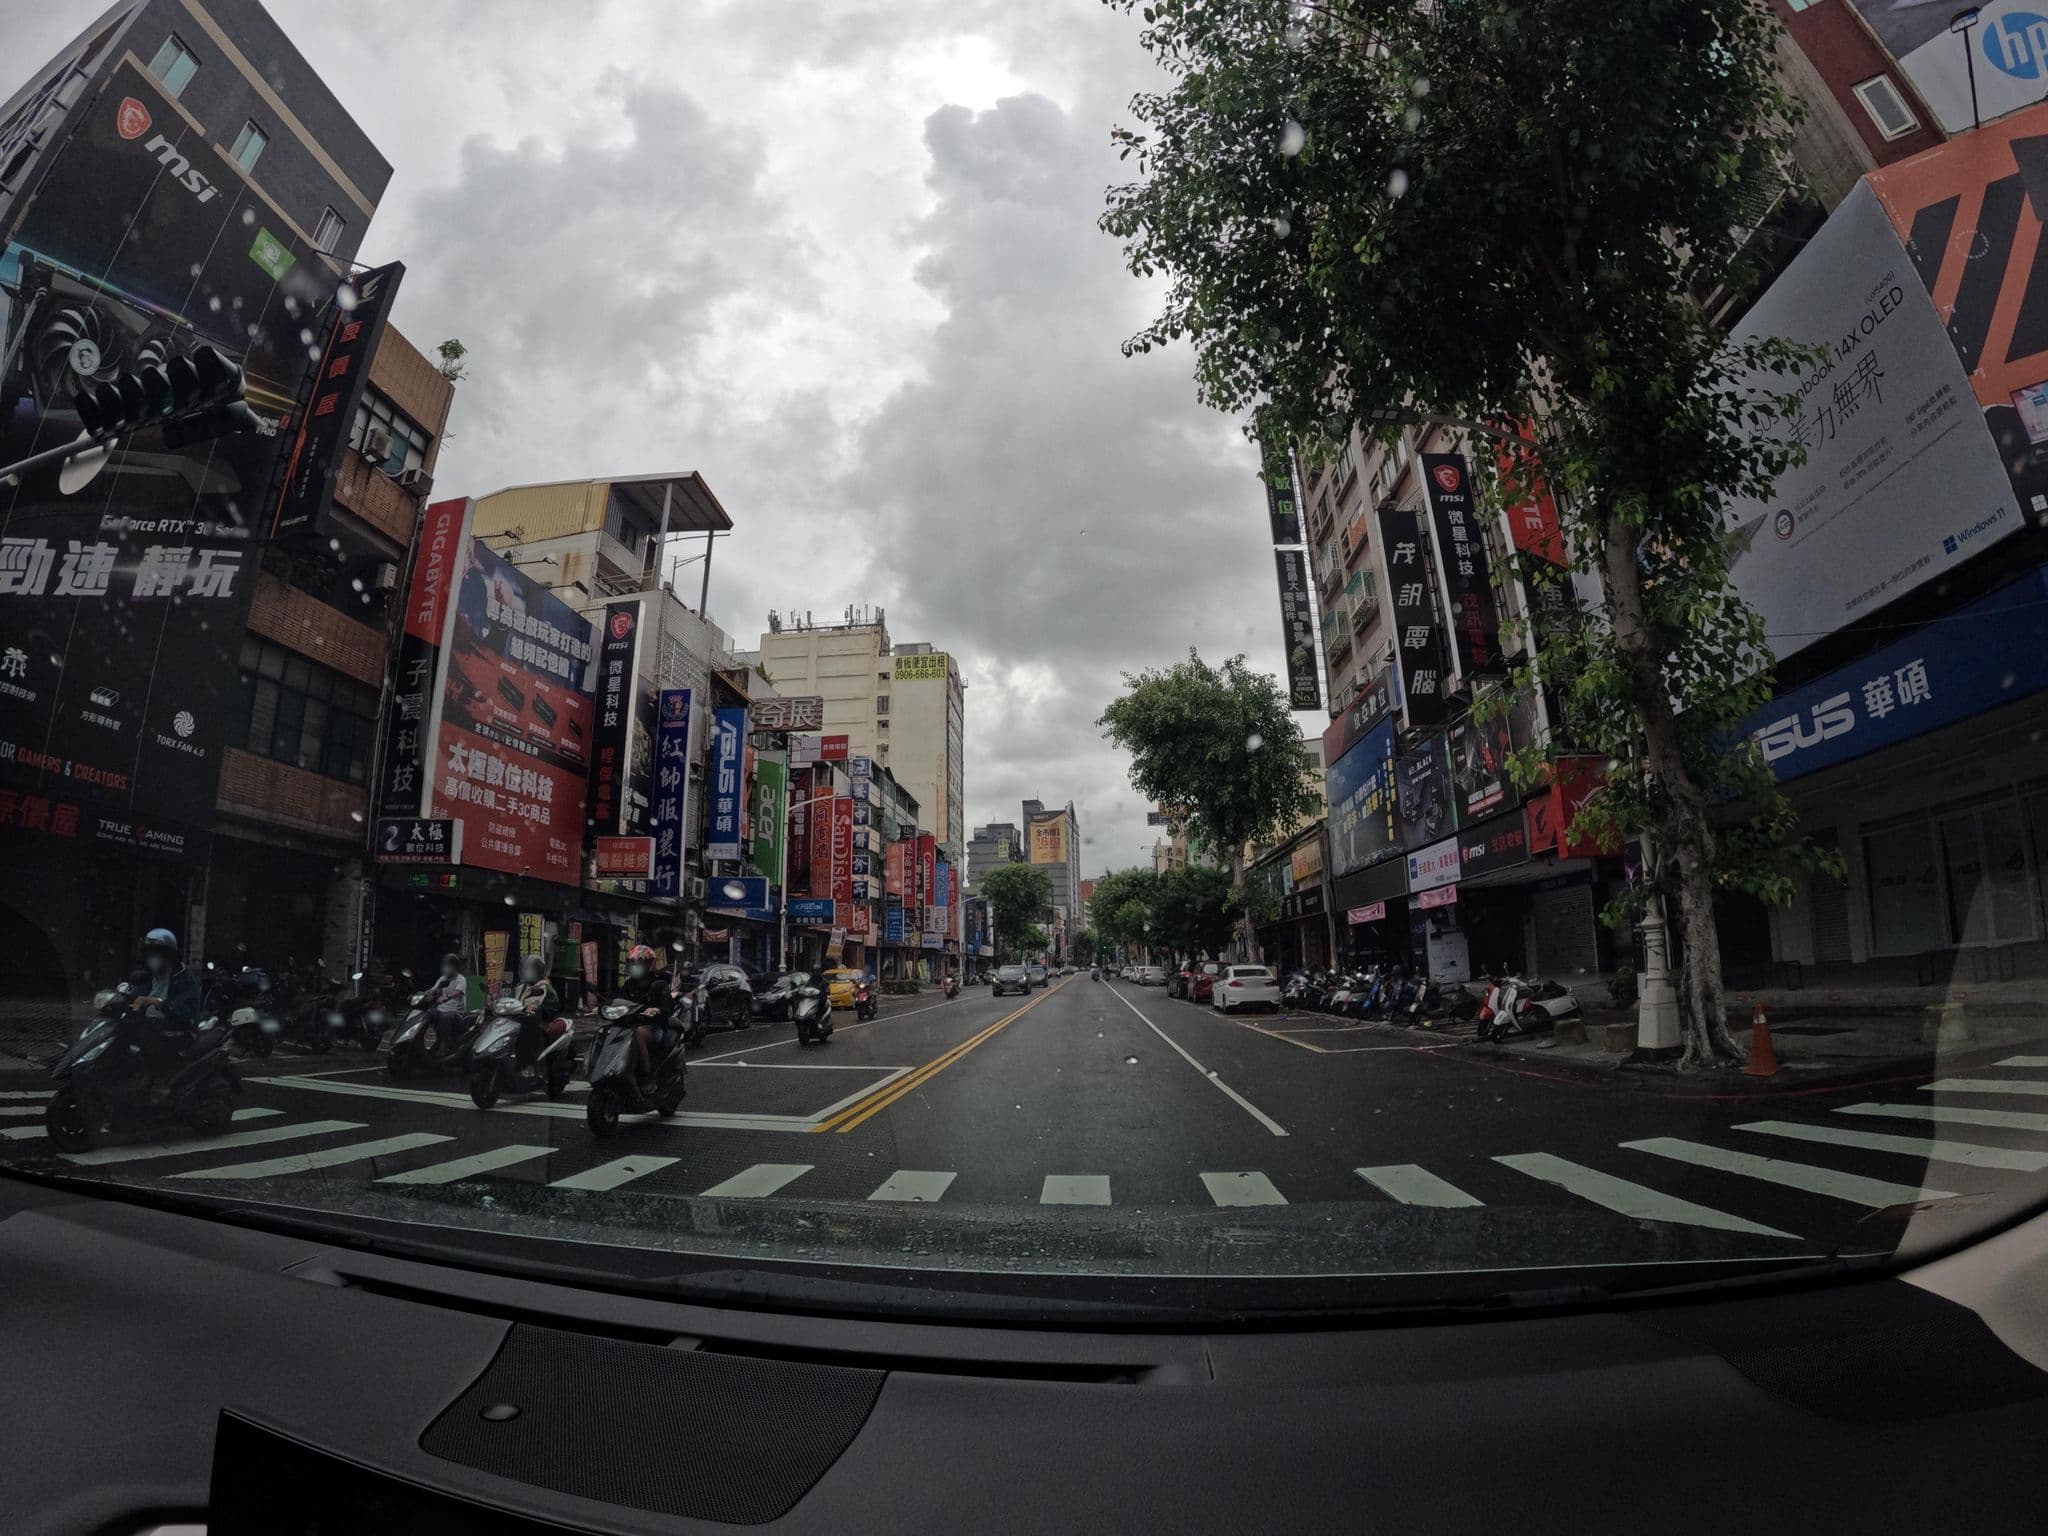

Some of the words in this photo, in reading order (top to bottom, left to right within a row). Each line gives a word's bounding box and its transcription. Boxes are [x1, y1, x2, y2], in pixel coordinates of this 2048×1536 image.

[144, 133, 218, 204] msi
[1834, 328, 1862, 362] 14X
[1861, 286, 1904, 335] OLED
[1440, 494, 1464, 502] msi
[1447, 510, 1474, 576] 微星科技
[1957, 511, 1997, 543] Windows
[418, 512, 449, 624] GIGABYTE
[608, 641, 630, 650] msi
[1393, 542, 1437, 695] 茂訊電腦
[895, 655, 946, 670] 看板便宜出租
[895, 669, 946, 680] 0906-666-603
[1861, 657, 1932, 720] 華碩
[603, 660, 624, 727] 微星科技
[18, 748, 62, 774] GAMERS
[64, 761, 72, 777] &
[74, 762, 129, 791] CREATORS
[448, 742, 554, 804] 太極數位科技
[718, 719, 738, 794] ASUS
[444, 777, 551, 826] 高價收購二手3C商品
[655, 734, 684, 892] 紅帥服裝行
[716, 798, 733, 832] 華碩
[759, 784, 776, 849] acer
[99, 819, 133, 835] TRUE
[135, 824, 185, 846] GAMING
[410, 822, 444, 841] 太極
[833, 813, 851, 891] SanDisk
[1468, 843, 1486, 859] msi
[795, 902, 823, 911] crucial
